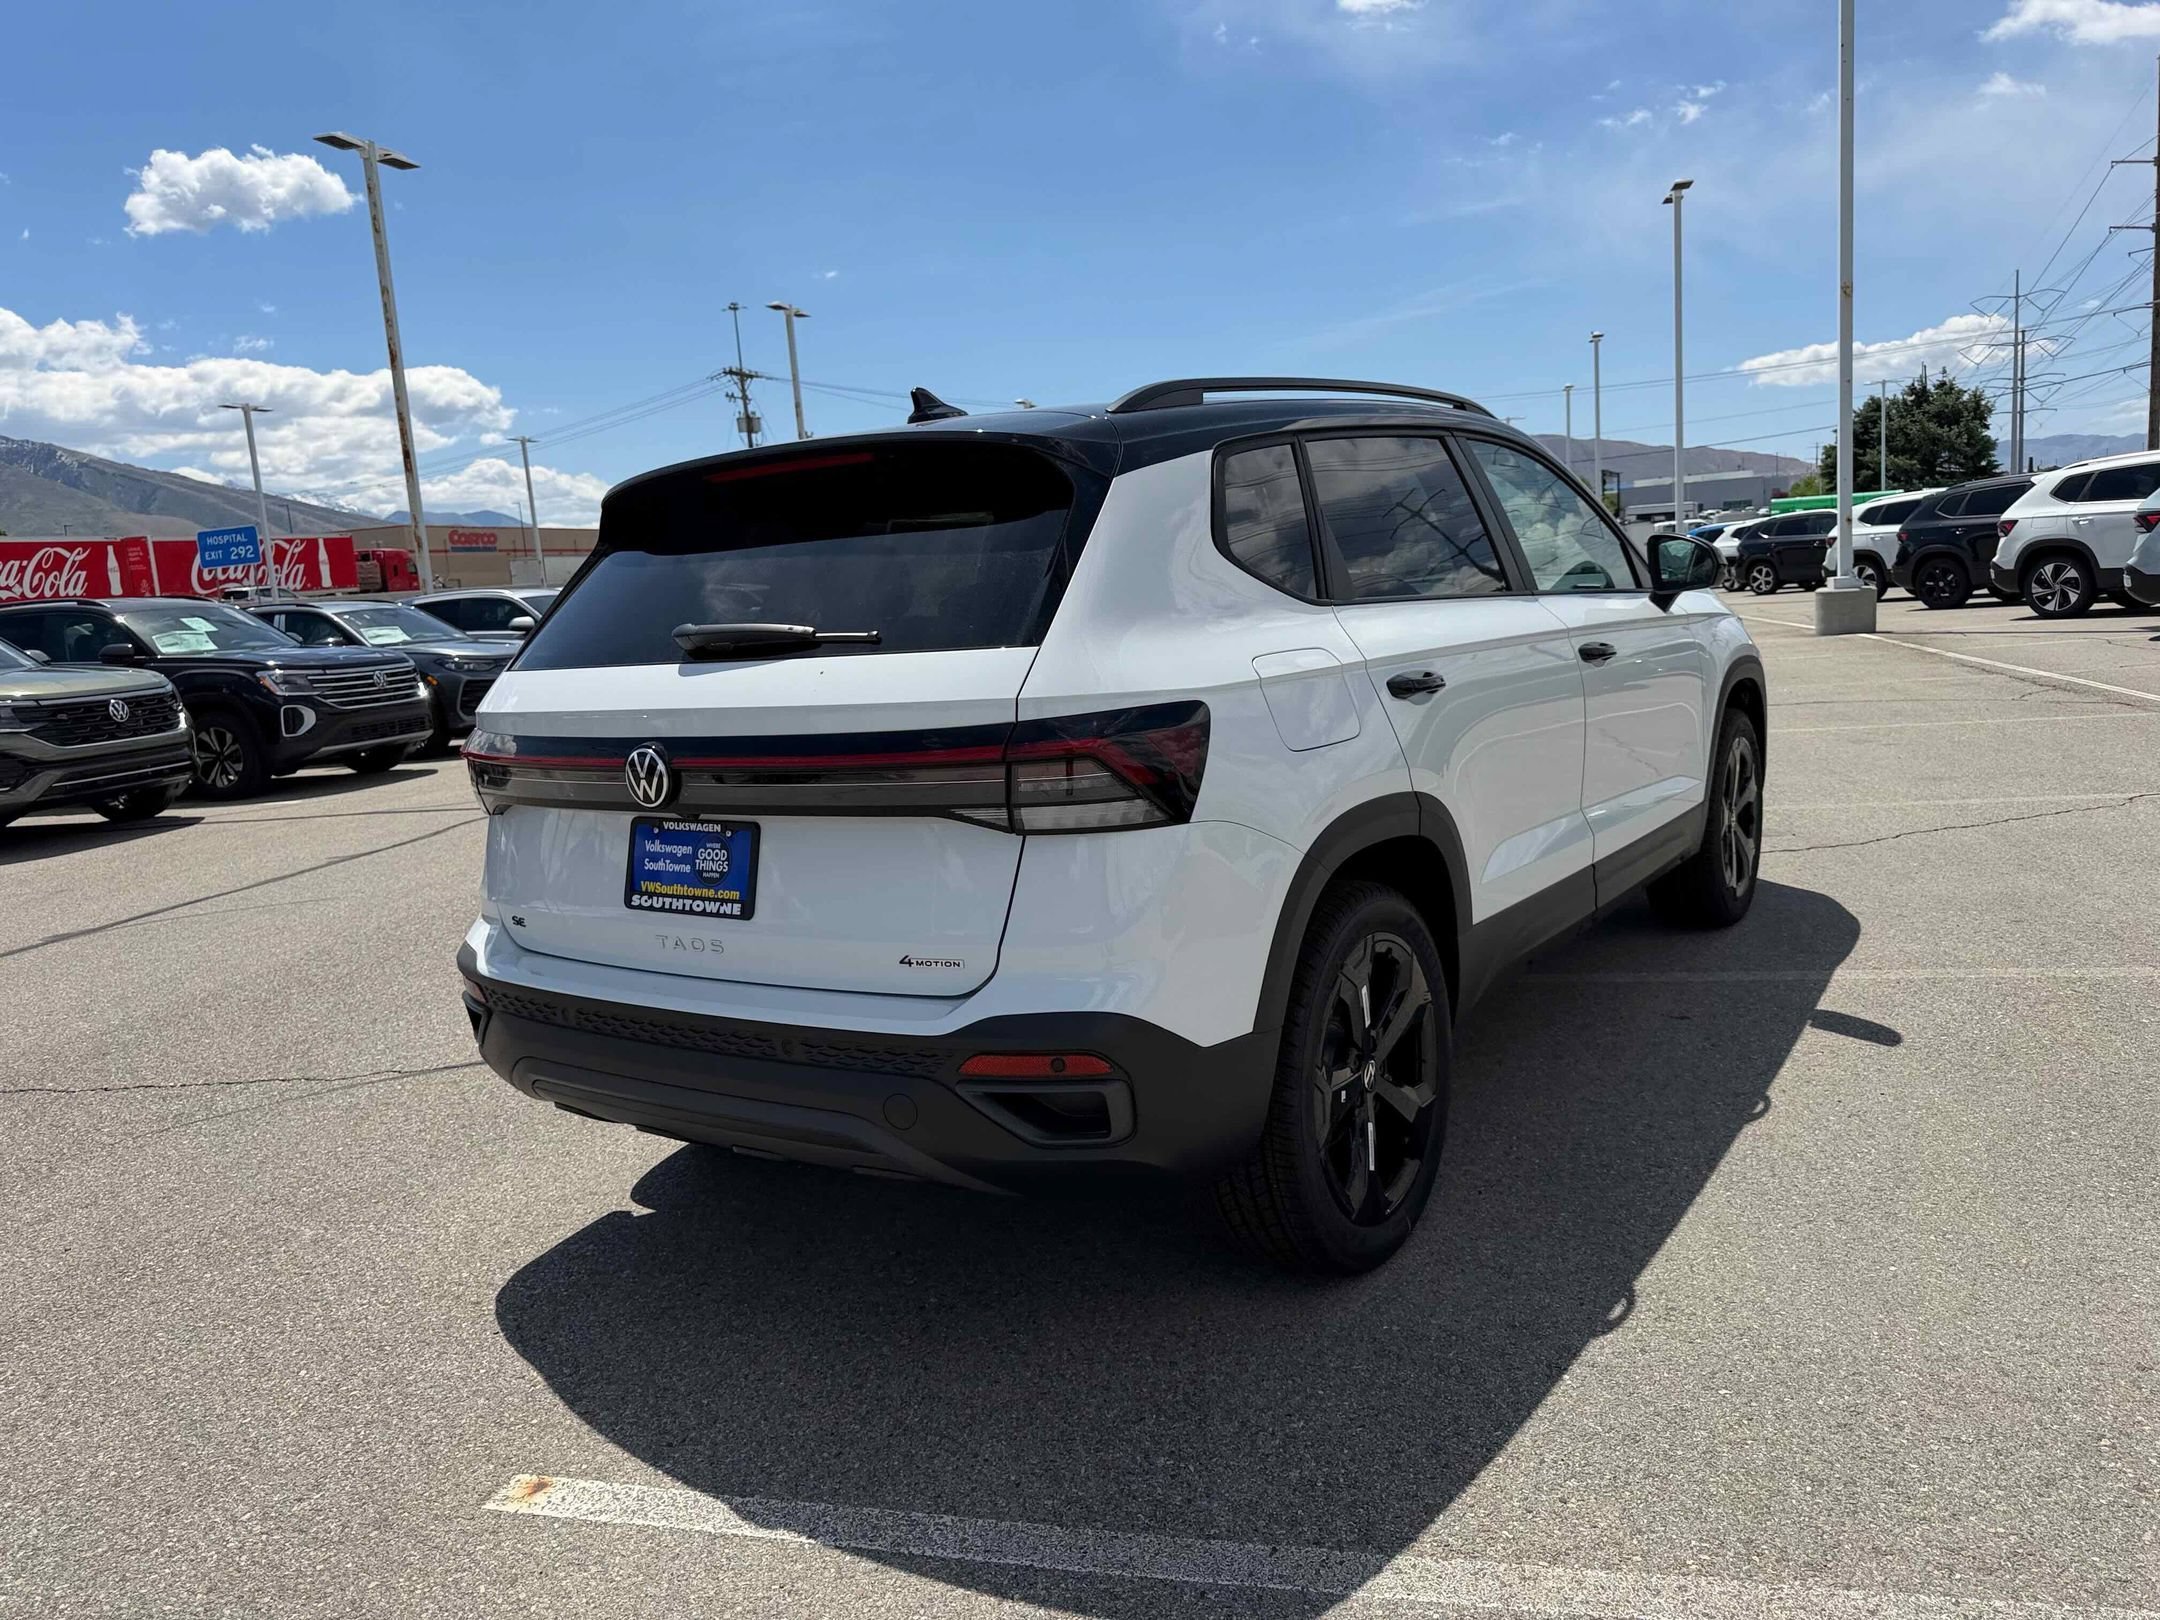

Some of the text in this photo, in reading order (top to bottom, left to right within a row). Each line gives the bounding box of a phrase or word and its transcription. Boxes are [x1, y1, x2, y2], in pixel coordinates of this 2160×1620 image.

[206, 533, 248, 546] HOSPITAL
[205, 545, 255, 561] EXIT 292
[626, 748, 668, 807] VW
[663, 821, 721, 832] VOLKSWAGEN
[645, 840, 692, 857] Volkswagen
[698, 848, 728, 861] GOOD
[644, 858, 691, 873] SouthTowne
[695, 859, 729, 872] THINGS
[640, 881, 740, 900] VWSouthtowne.com
[630, 894, 742, 915] SOUTHTOWNE
[511, 915, 526, 927] SE
[655, 934, 725, 954] TAOS
